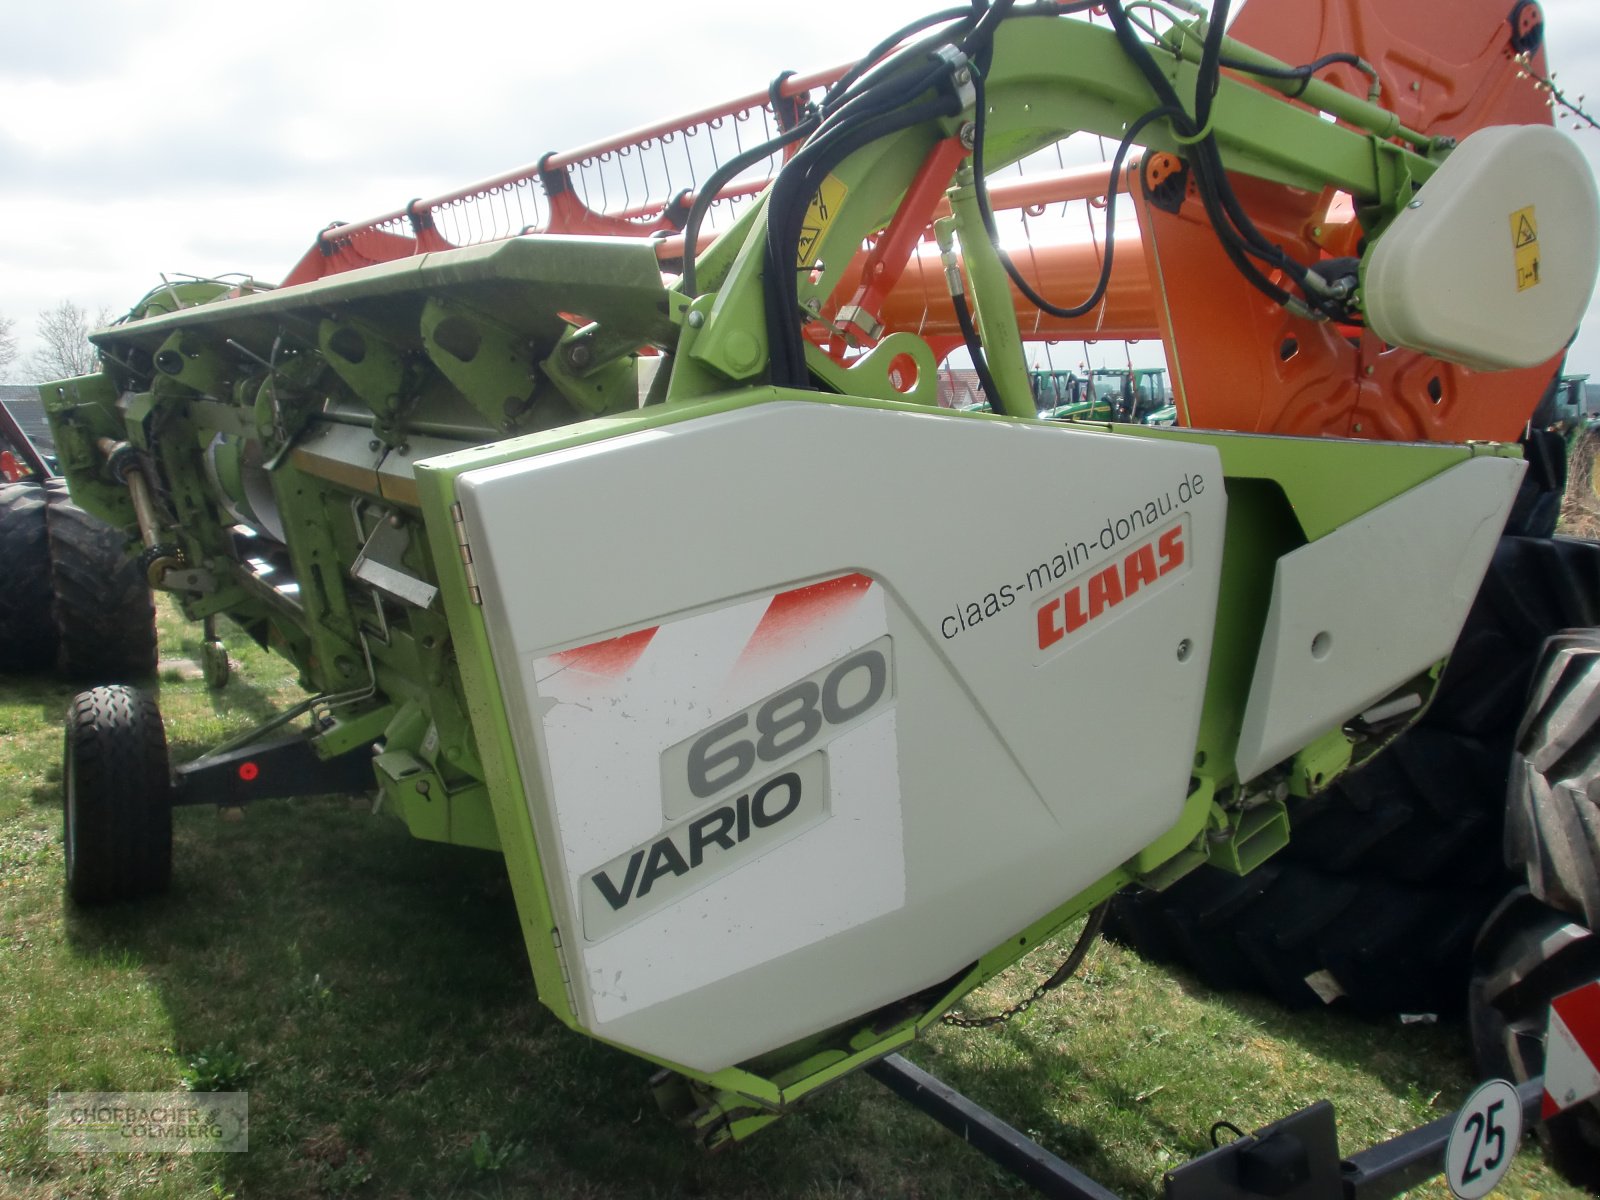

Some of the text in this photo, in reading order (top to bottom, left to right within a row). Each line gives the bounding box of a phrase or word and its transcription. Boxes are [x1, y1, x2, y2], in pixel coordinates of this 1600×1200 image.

[941, 473, 1205, 639] claas-main-donau.de
[1037, 524, 1185, 650] CLAAS
[687, 650, 886, 798] 680
[591, 772, 802, 911] VARIO
[1462, 1099, 1505, 1186] 25
